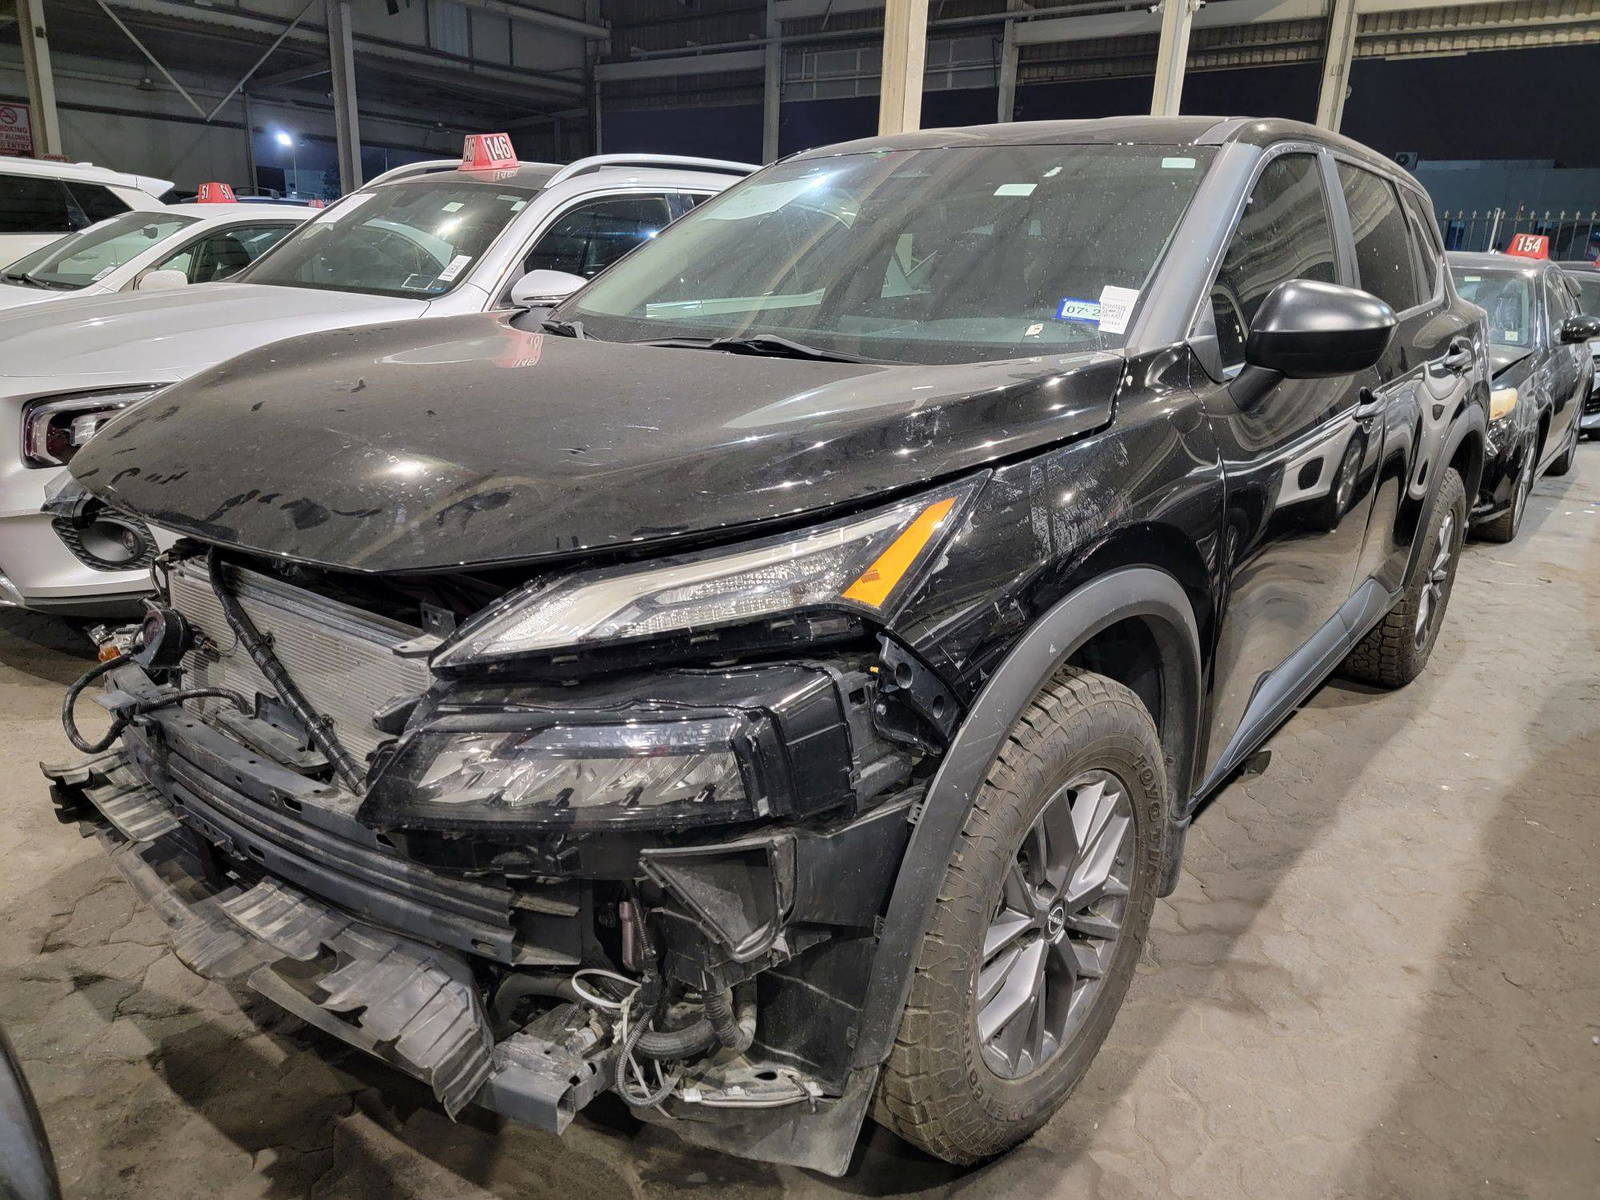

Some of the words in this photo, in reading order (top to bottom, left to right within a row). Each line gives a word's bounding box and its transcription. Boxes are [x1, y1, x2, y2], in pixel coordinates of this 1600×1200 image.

[486, 136, 513, 161] 146
[202, 184, 209, 200] 51
[219, 184, 232, 200] 51
[1518, 236, 1542, 253] 154
[1066, 306, 1085, 315] 07
[1132, 754, 1161, 822] TOYO
